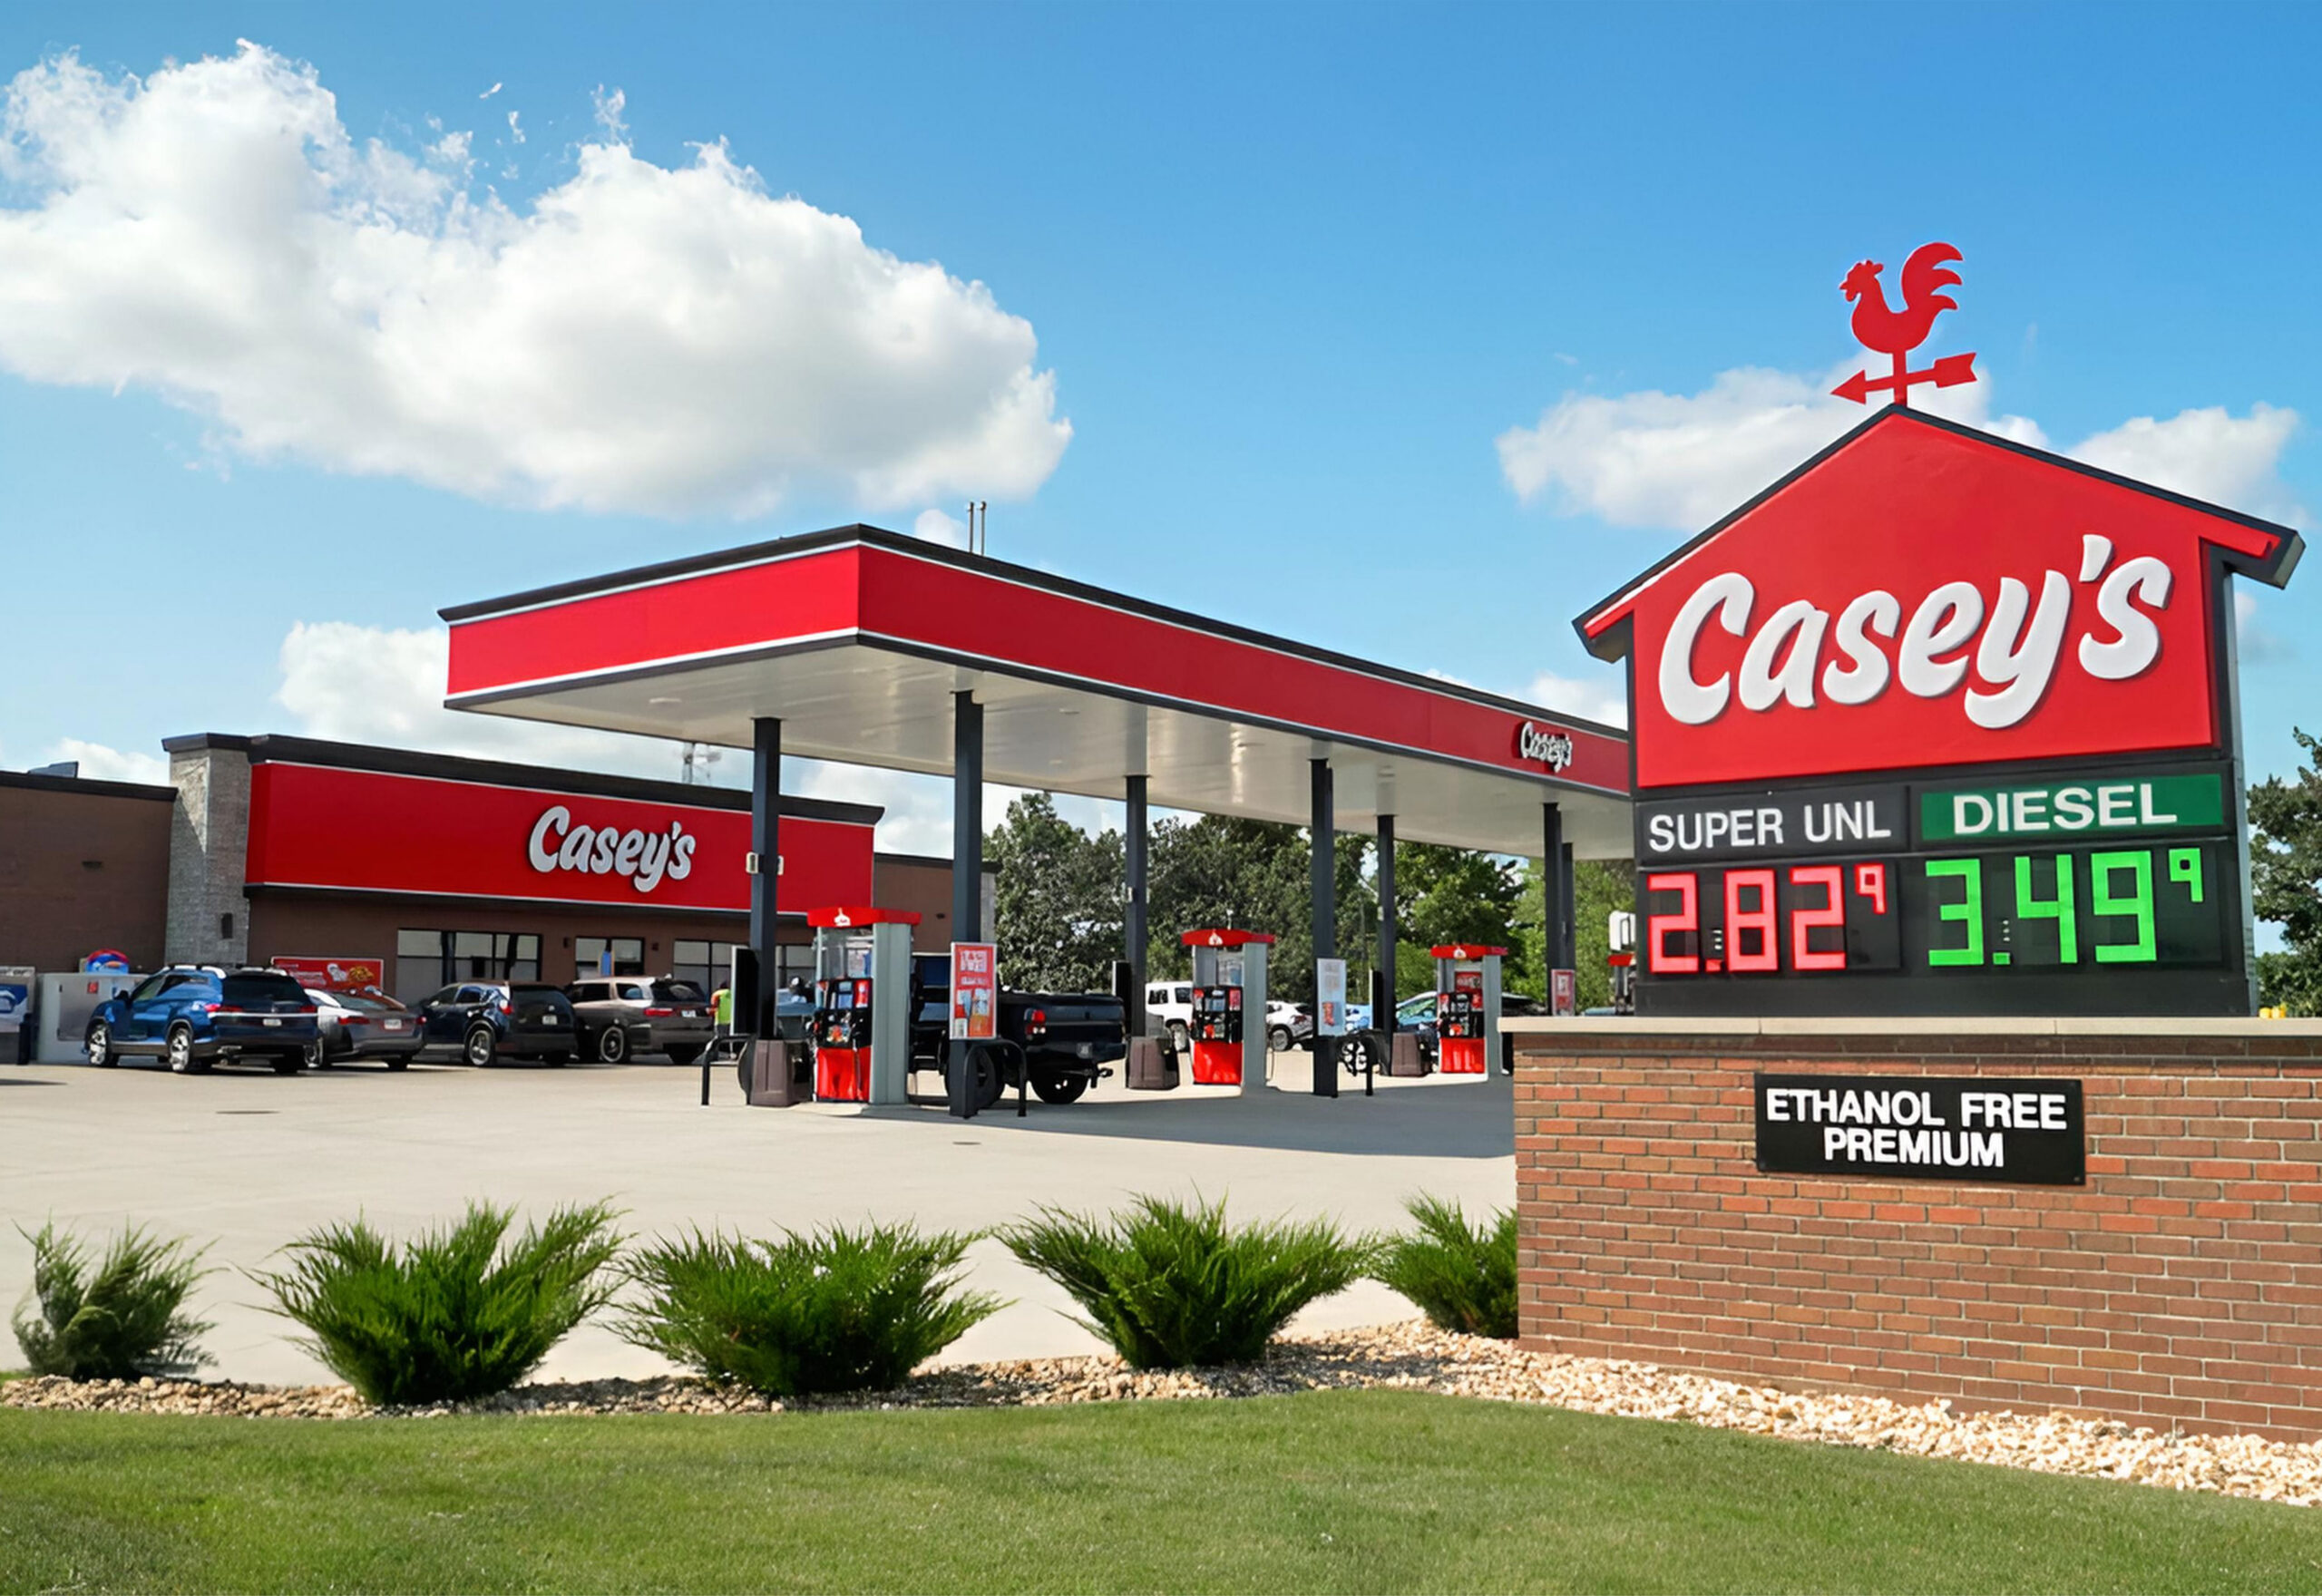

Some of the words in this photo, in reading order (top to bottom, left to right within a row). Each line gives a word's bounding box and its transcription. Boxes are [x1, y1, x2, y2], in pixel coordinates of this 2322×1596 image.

[1658, 534, 2172, 729] Casey's
[1520, 721, 1573, 774] Casey's
[1649, 808, 1784, 852] SUPER
[1804, 801, 1891, 842] UNL
[1953, 783, 2177, 835] DIESEL
[529, 805, 696, 893] Casey's
[1765, 1088, 1945, 1128] ETHANOL
[1960, 1091, 2068, 1131] FREE
[1823, 1125, 2005, 1169] PREMIUM
